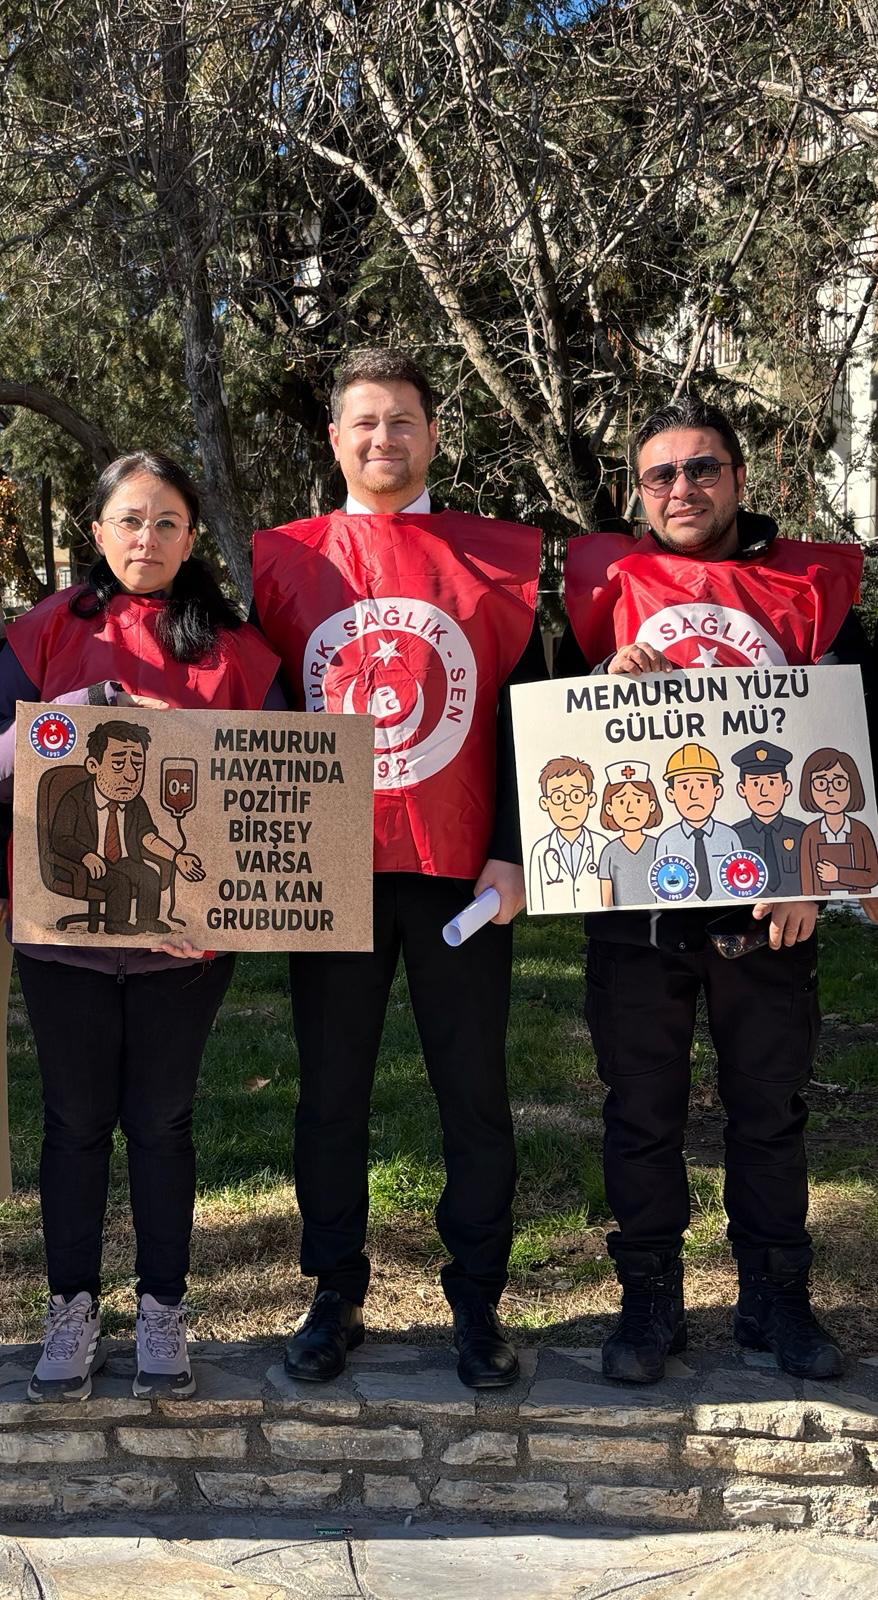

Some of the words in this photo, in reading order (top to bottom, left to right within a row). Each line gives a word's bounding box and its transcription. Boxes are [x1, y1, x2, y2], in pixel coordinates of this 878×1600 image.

[659, 612, 767, 660] SAĞLIK
[343, 605, 448, 645] SAĞLIK
[446, 667, 466, 723] SEN
[566, 676, 728, 713] MEMURUN
[736, 669, 809, 700] YÜZÜ
[605, 709, 706, 744] GÜLÜR
[722, 704, 786, 736] MÜ?
[214, 728, 336, 755] MEMURUN
[210, 757, 345, 784] HAYATINDA
[377, 758, 410, 778] 92
[223, 784, 311, 814] POZİTİF
[229, 815, 313, 849] BİRŞEY
[235, 850, 313, 874] VARSA
[218, 878, 268, 902] ODA
[275, 880, 323, 903] KAN
[206, 907, 334, 931] GRUBUDUR
